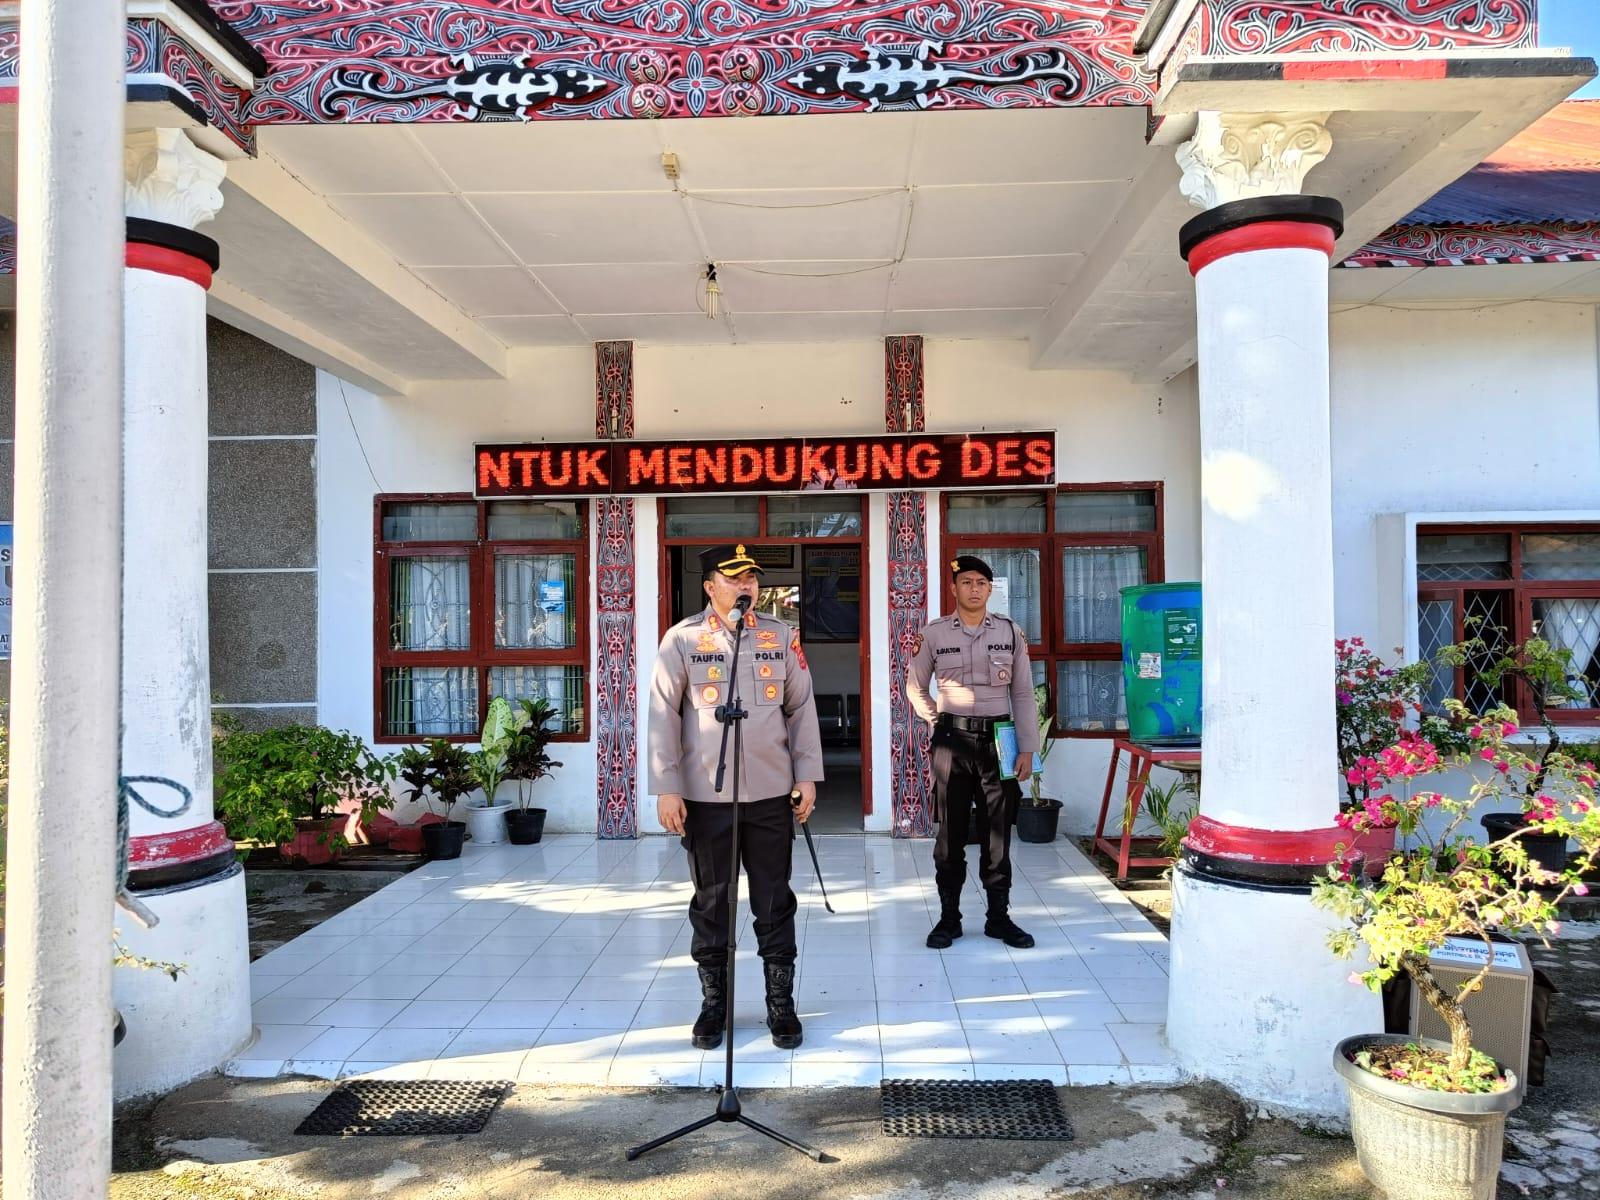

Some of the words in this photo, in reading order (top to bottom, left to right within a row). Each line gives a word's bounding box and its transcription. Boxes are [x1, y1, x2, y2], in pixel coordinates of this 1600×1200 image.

[480, 449, 608, 486] NTUK
[629, 444, 939, 484] MENDUKUNG
[961, 440, 1051, 477] DES
[690, 654, 725, 663] TAUFIQ
[755, 652, 784, 661] POLRI
